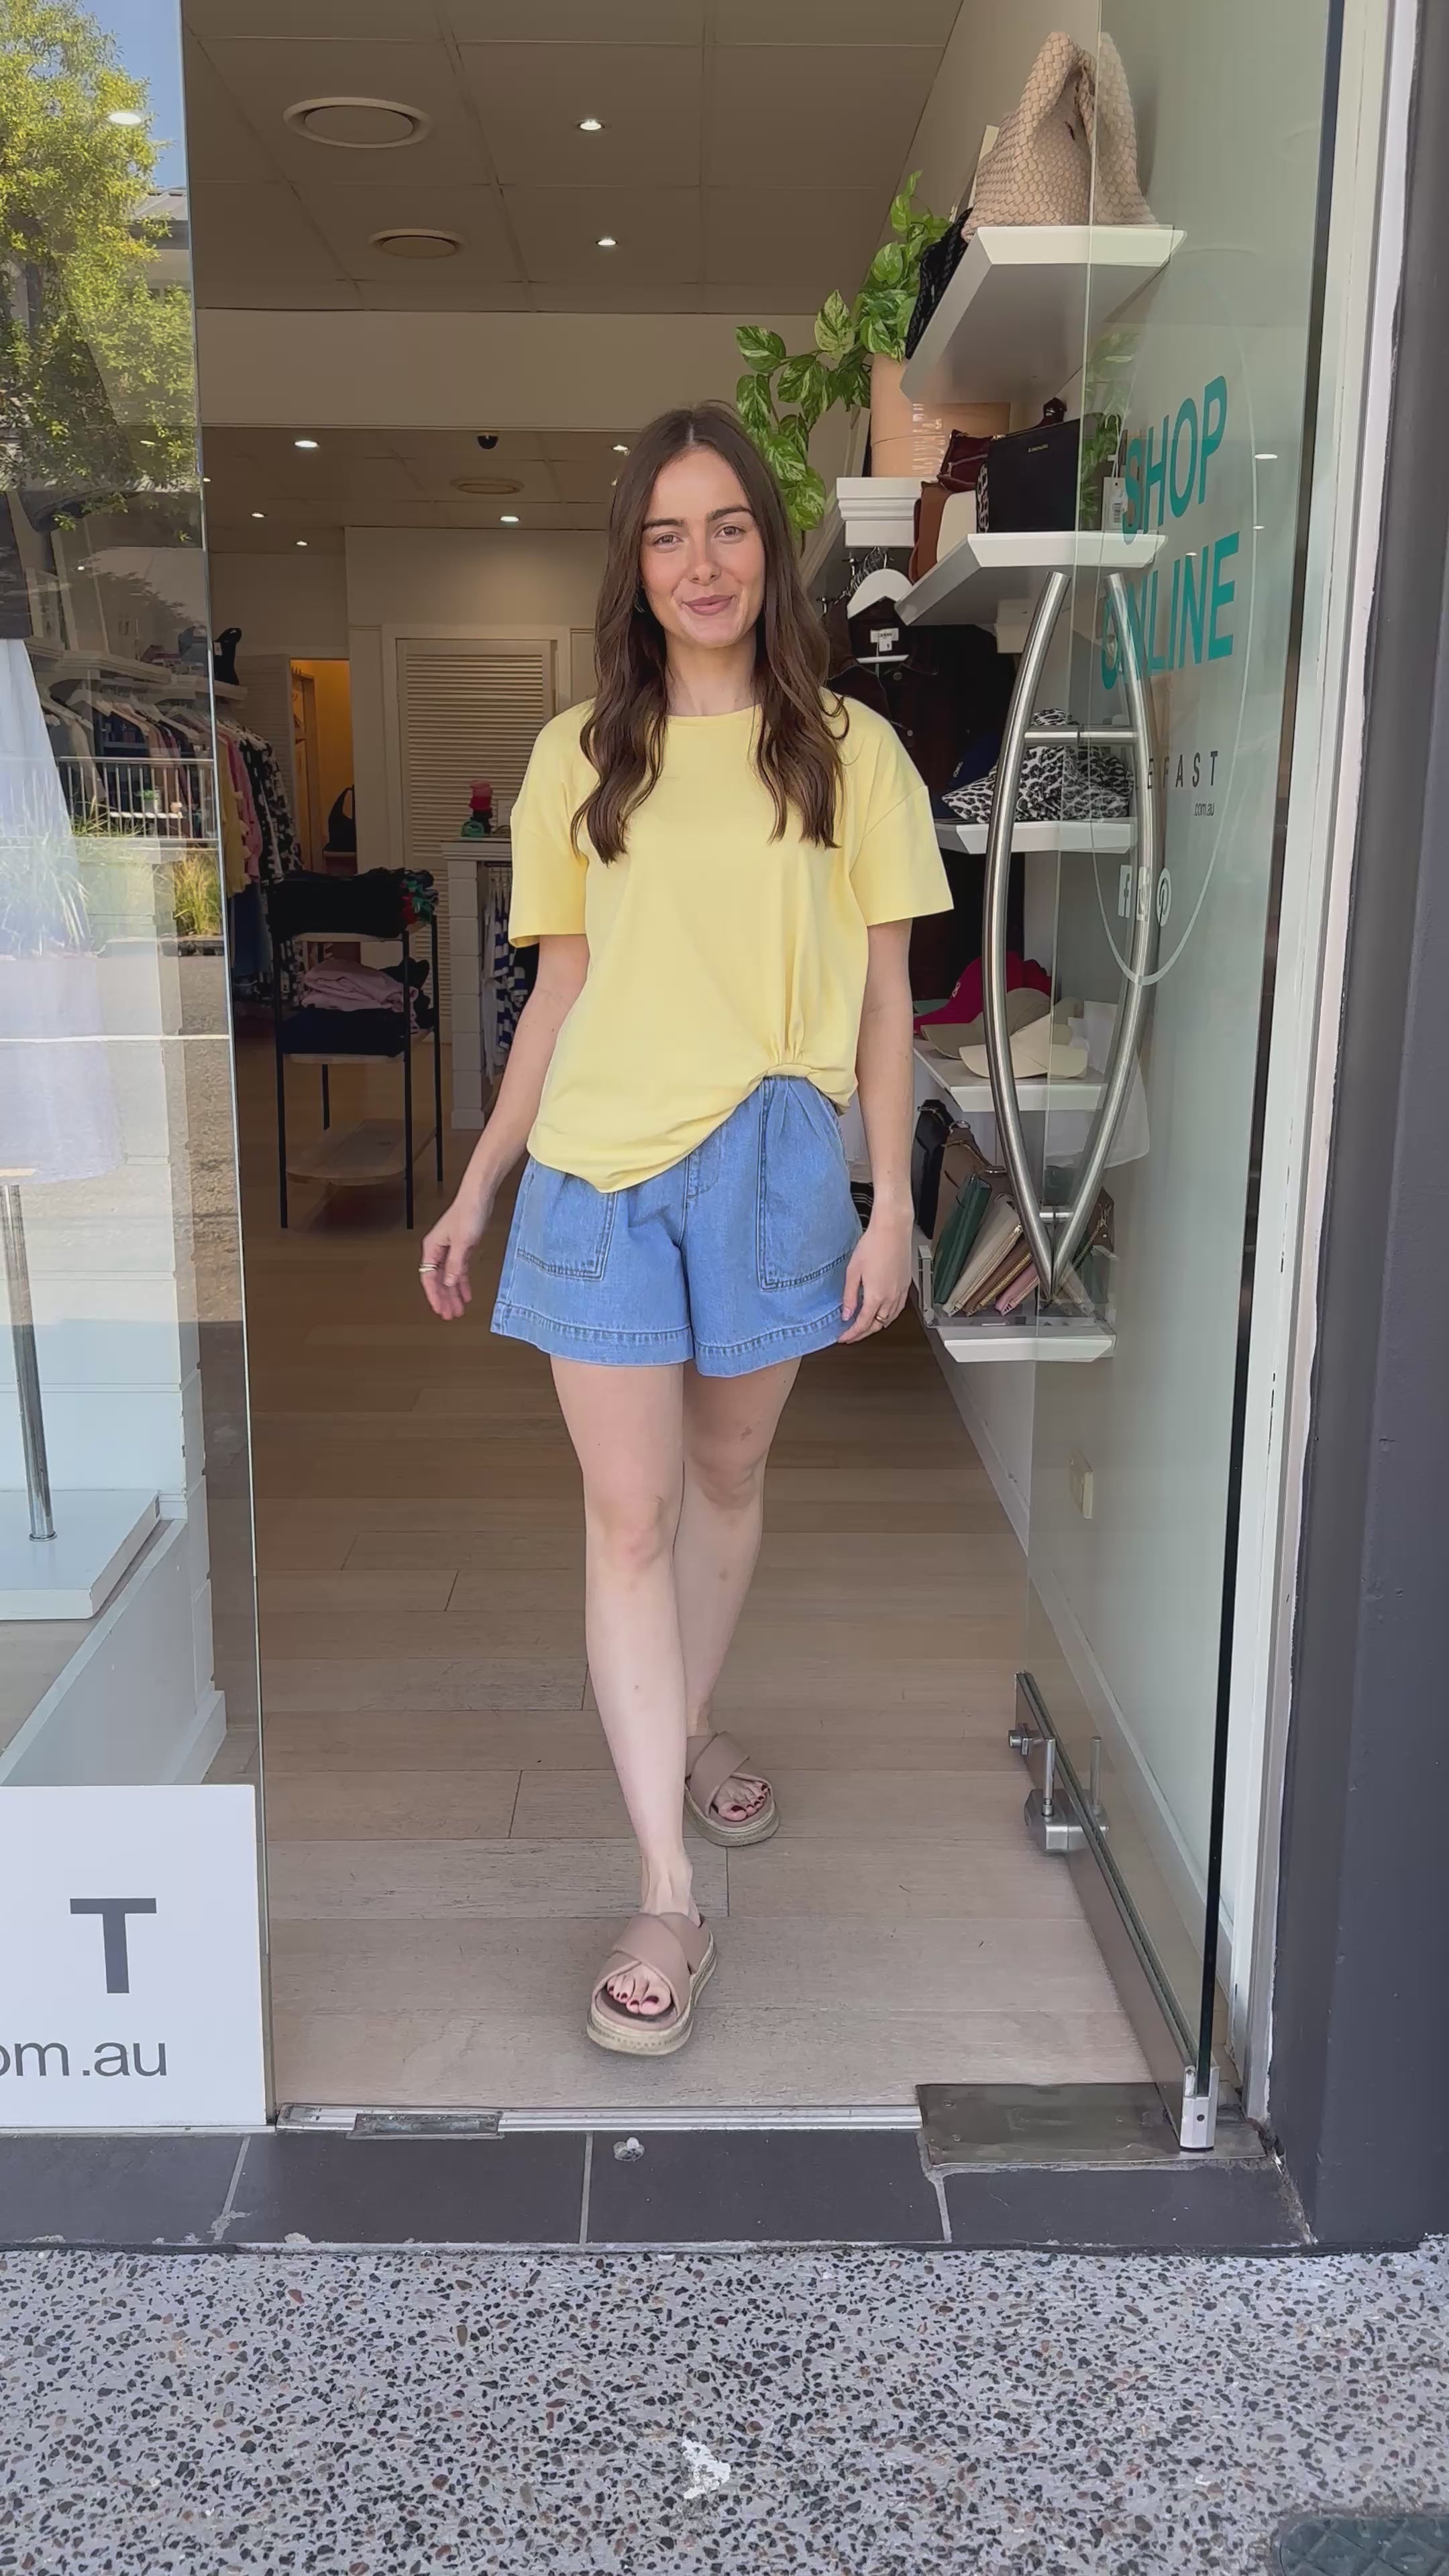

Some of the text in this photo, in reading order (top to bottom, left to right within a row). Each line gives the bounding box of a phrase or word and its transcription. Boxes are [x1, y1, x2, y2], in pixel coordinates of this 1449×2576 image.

[1122, 376, 1227, 545] SHOP
[1102, 531, 1240, 690] ONLINE
[70, 1897, 157, 1994] T
